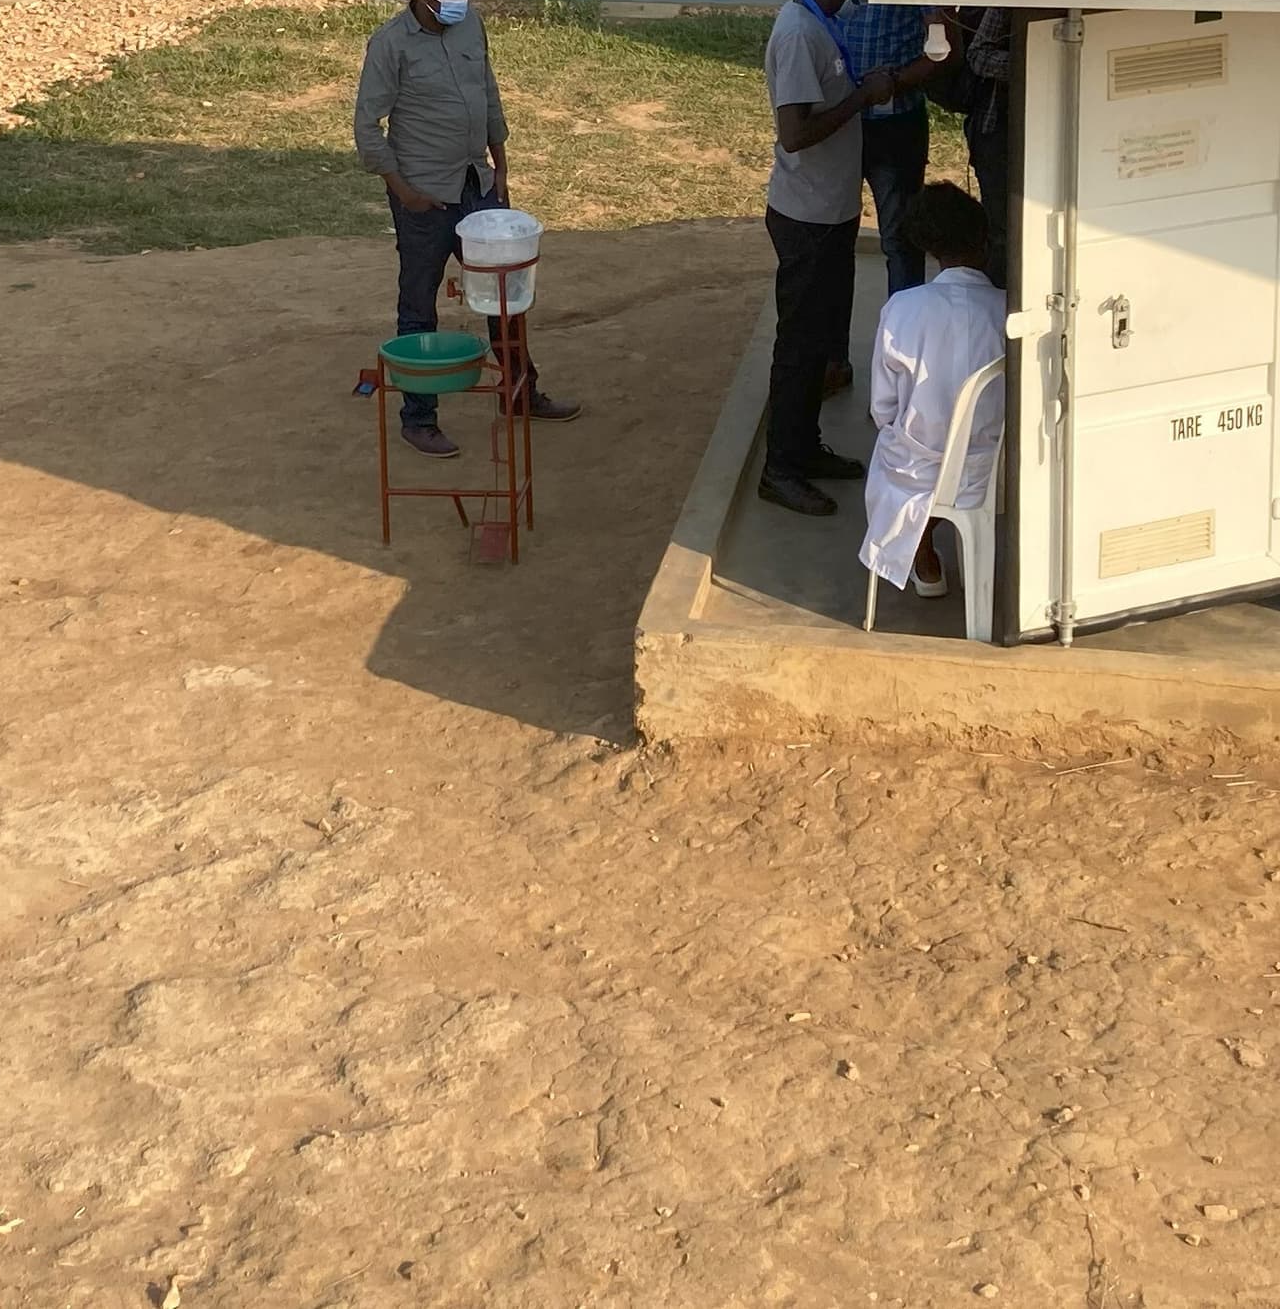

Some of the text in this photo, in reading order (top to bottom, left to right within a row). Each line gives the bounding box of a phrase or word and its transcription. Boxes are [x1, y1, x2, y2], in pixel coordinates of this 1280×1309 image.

[1170, 403, 1263, 441] TARE 450 KG
